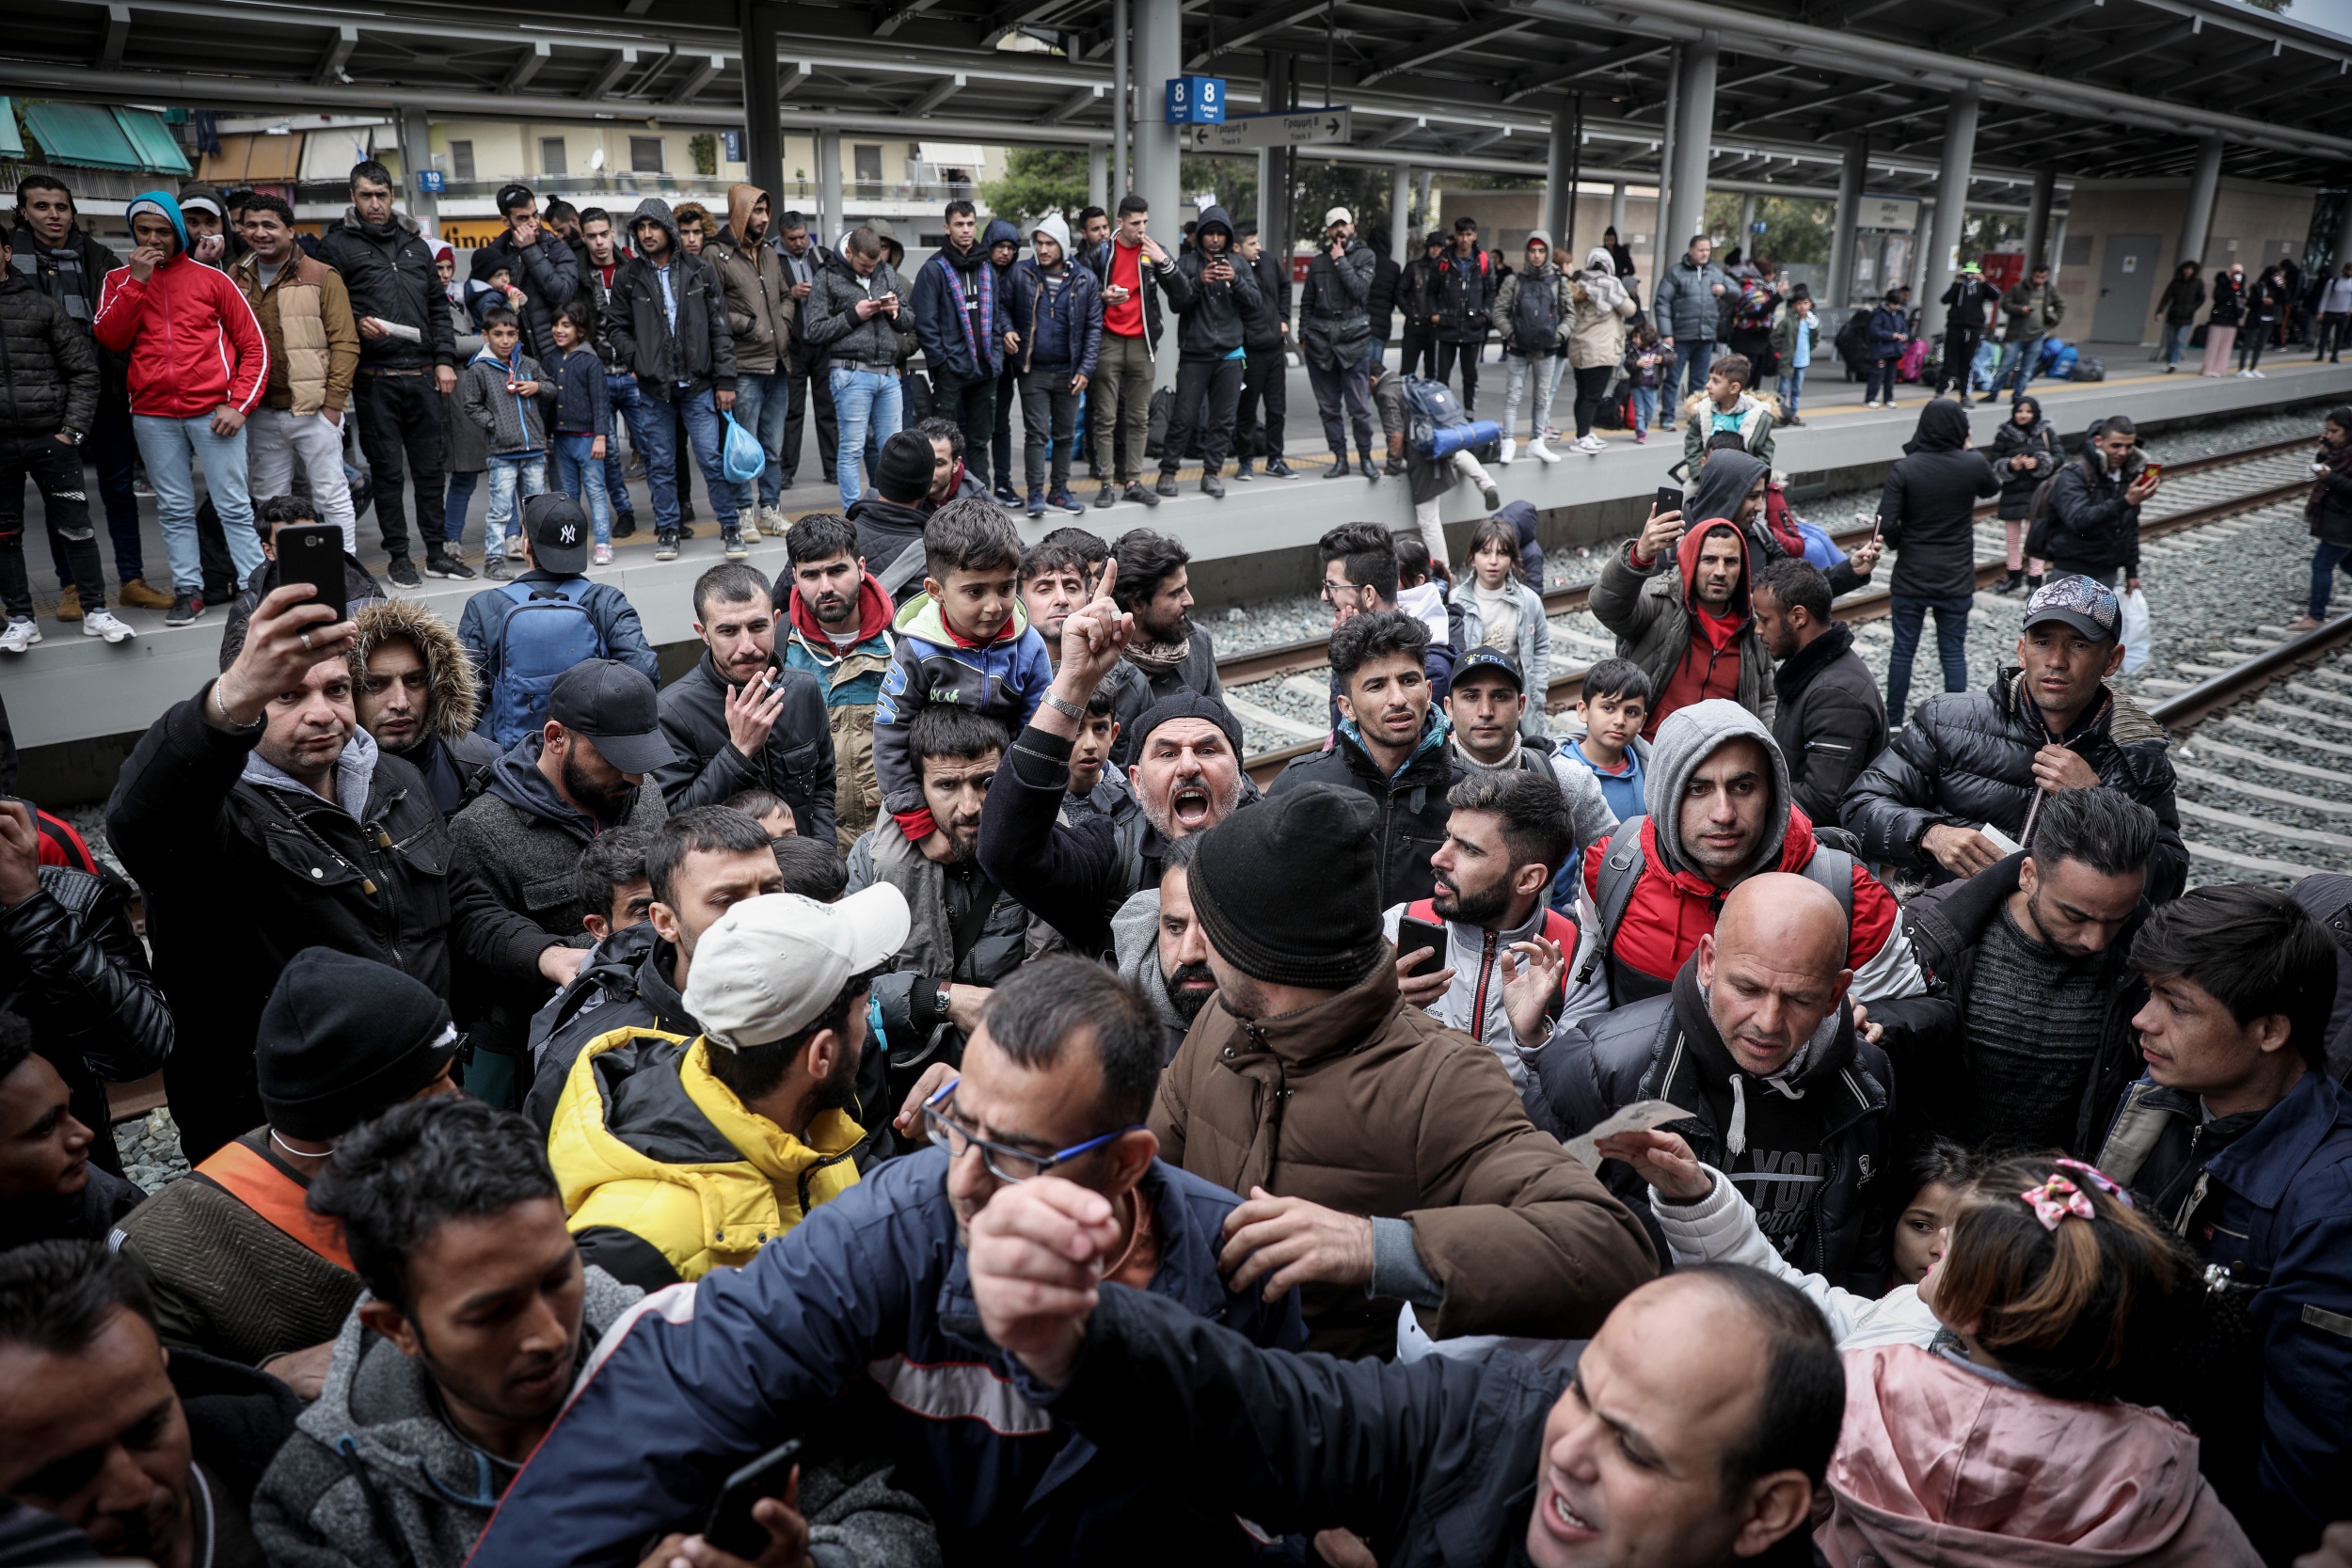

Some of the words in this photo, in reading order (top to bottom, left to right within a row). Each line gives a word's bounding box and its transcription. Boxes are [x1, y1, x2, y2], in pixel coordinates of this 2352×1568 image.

[1175, 83, 1184, 103] 8
[1204, 82, 1215, 103] 8
[1215, 123, 1241, 135] Γραμμή
[1242, 121, 1248, 132] 9
[1283, 118, 1312, 130] Γραμμή
[1313, 116, 1319, 126] 8
[728, 134, 735, 149] 9
[425, 171, 440, 182] 10
[560, 524, 576, 544] NY
[1480, 654, 1506, 667] FRA
[1422, 1007, 1444, 1018] afone
